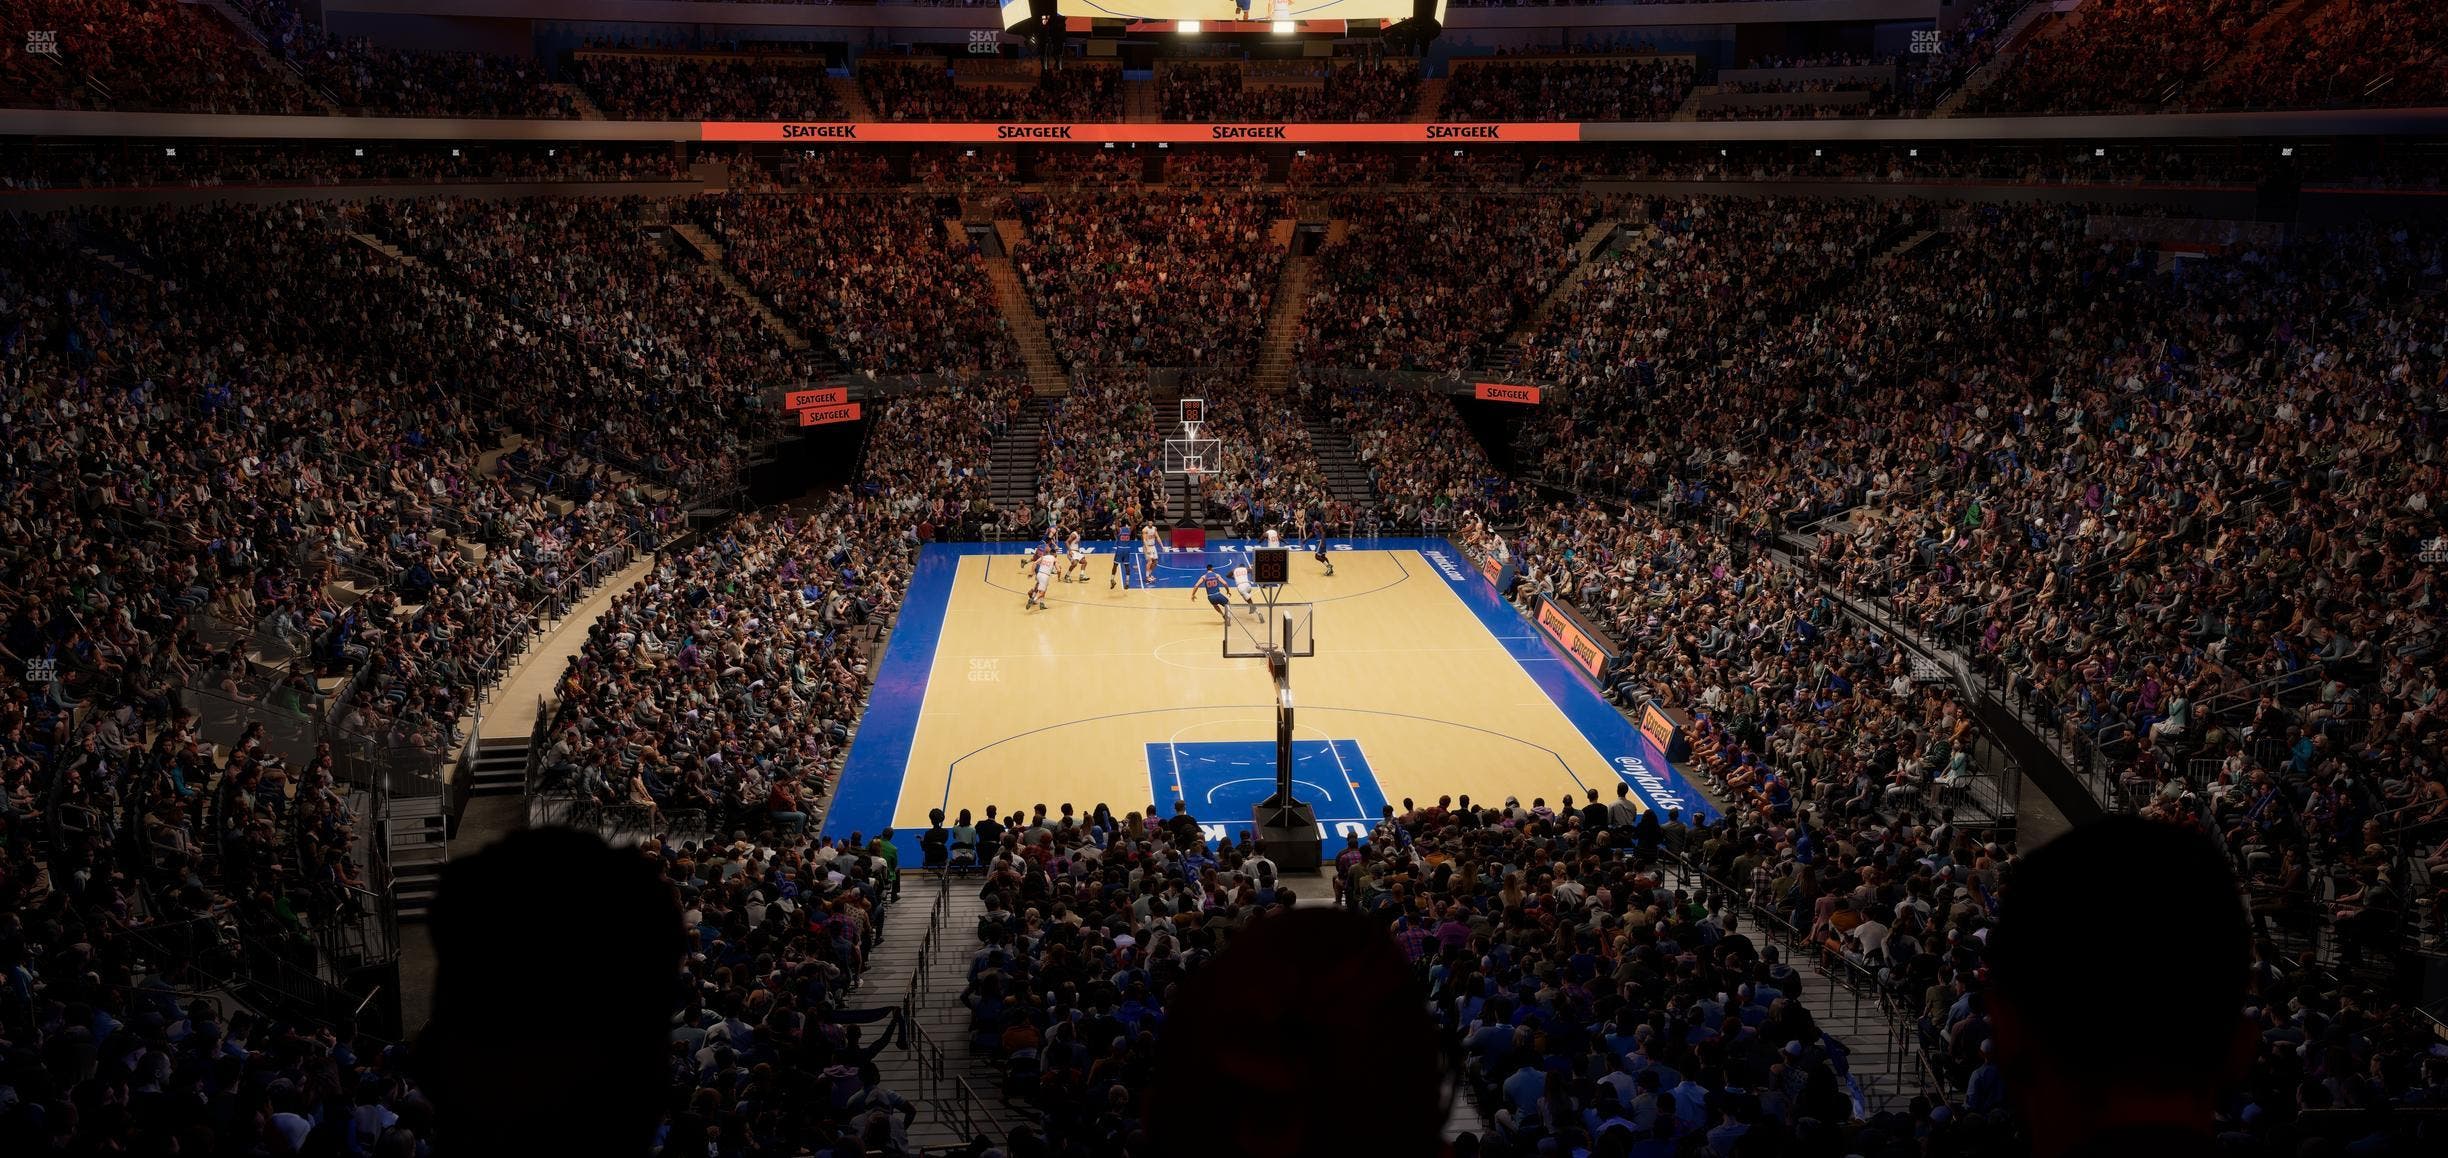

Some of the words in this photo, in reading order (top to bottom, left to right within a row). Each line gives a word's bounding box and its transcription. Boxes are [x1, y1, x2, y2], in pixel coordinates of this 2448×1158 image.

[783, 125, 856, 138] SEATGEEK
[998, 126, 1071, 138] SEATGEEK
[1213, 126, 1286, 138] SEATGEEK
[1427, 126, 1499, 138] SEATGEEK
[796, 392, 837, 406] SEATGEEK
[1487, 387, 1529, 400] SEATGEEK
[810, 408, 850, 422] SEATGEEK
[1543, 608, 1566, 640] SEATGEEK
[1571, 634, 1597, 669] SEATGEEK
[1643, 711, 1671, 749] SEATGEEK
[1614, 756, 1685, 810] @nyknicks
